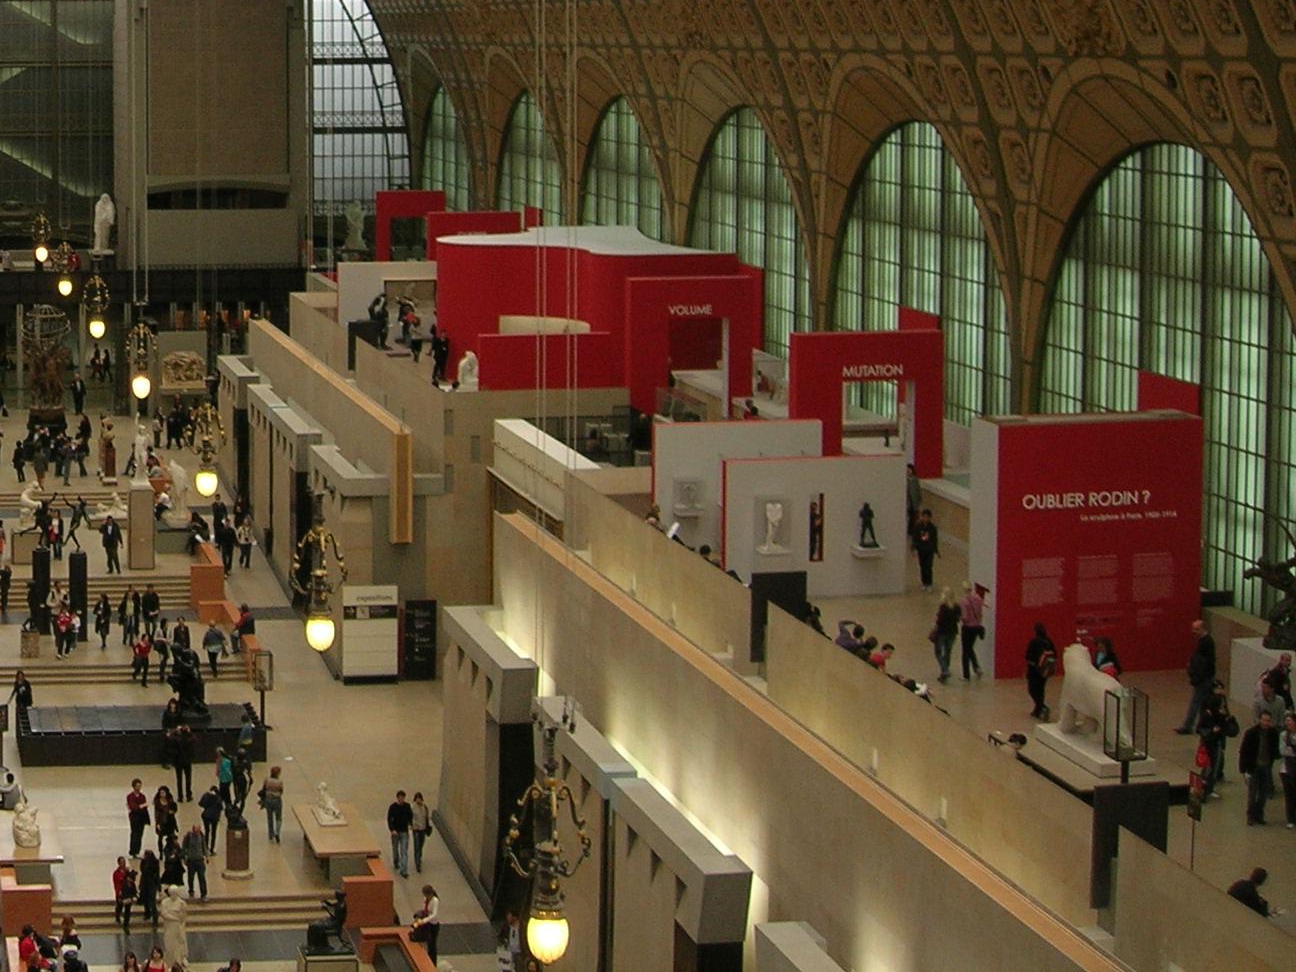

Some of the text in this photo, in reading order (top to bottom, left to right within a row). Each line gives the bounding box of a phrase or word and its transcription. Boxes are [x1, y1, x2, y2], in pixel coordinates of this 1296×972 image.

[668, 304, 713, 316] VOLUME
[842, 364, 904, 377] MUTATION
[1022, 489, 1152, 510] OUBLIER RODIN ?
